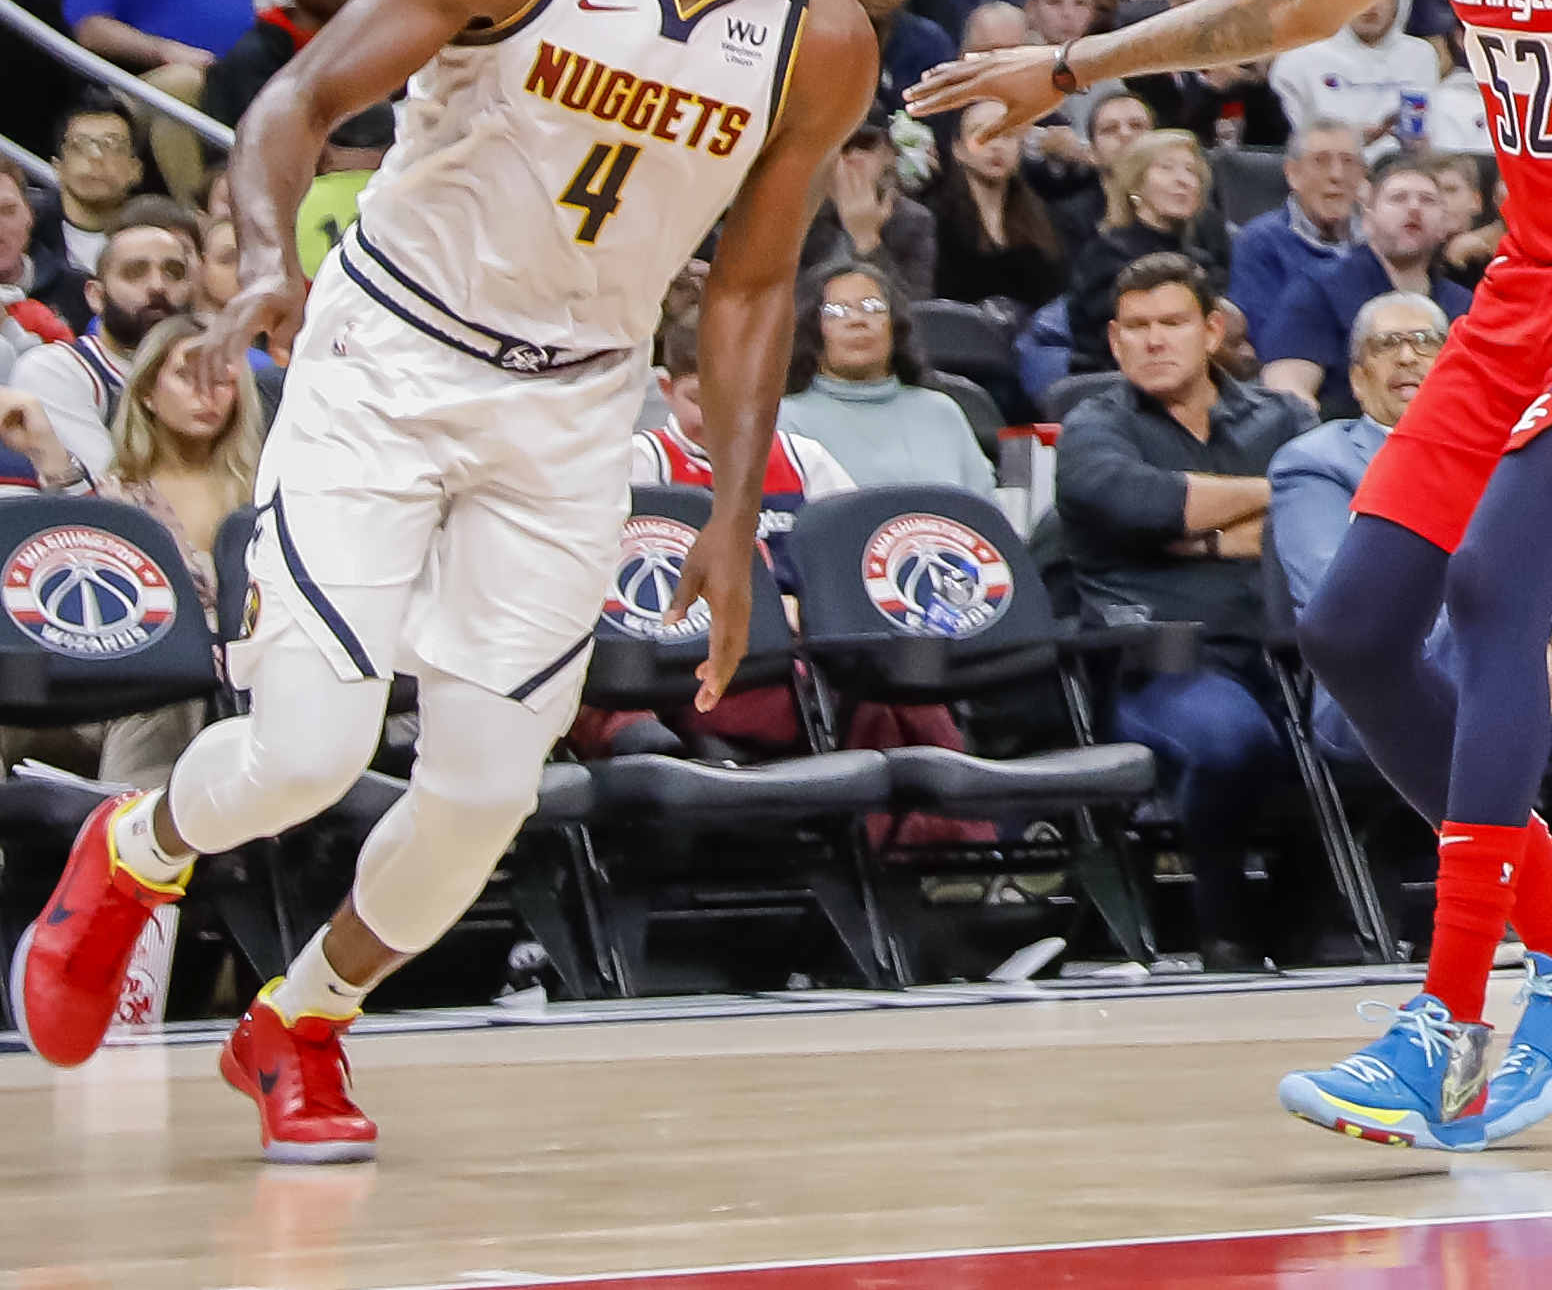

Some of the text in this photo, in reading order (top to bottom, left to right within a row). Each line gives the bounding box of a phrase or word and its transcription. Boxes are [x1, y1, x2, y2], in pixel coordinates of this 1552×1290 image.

[726, 16, 768, 47] WU
[523, 38, 753, 159] NUGGETS
[555, 140, 643, 247] 4
